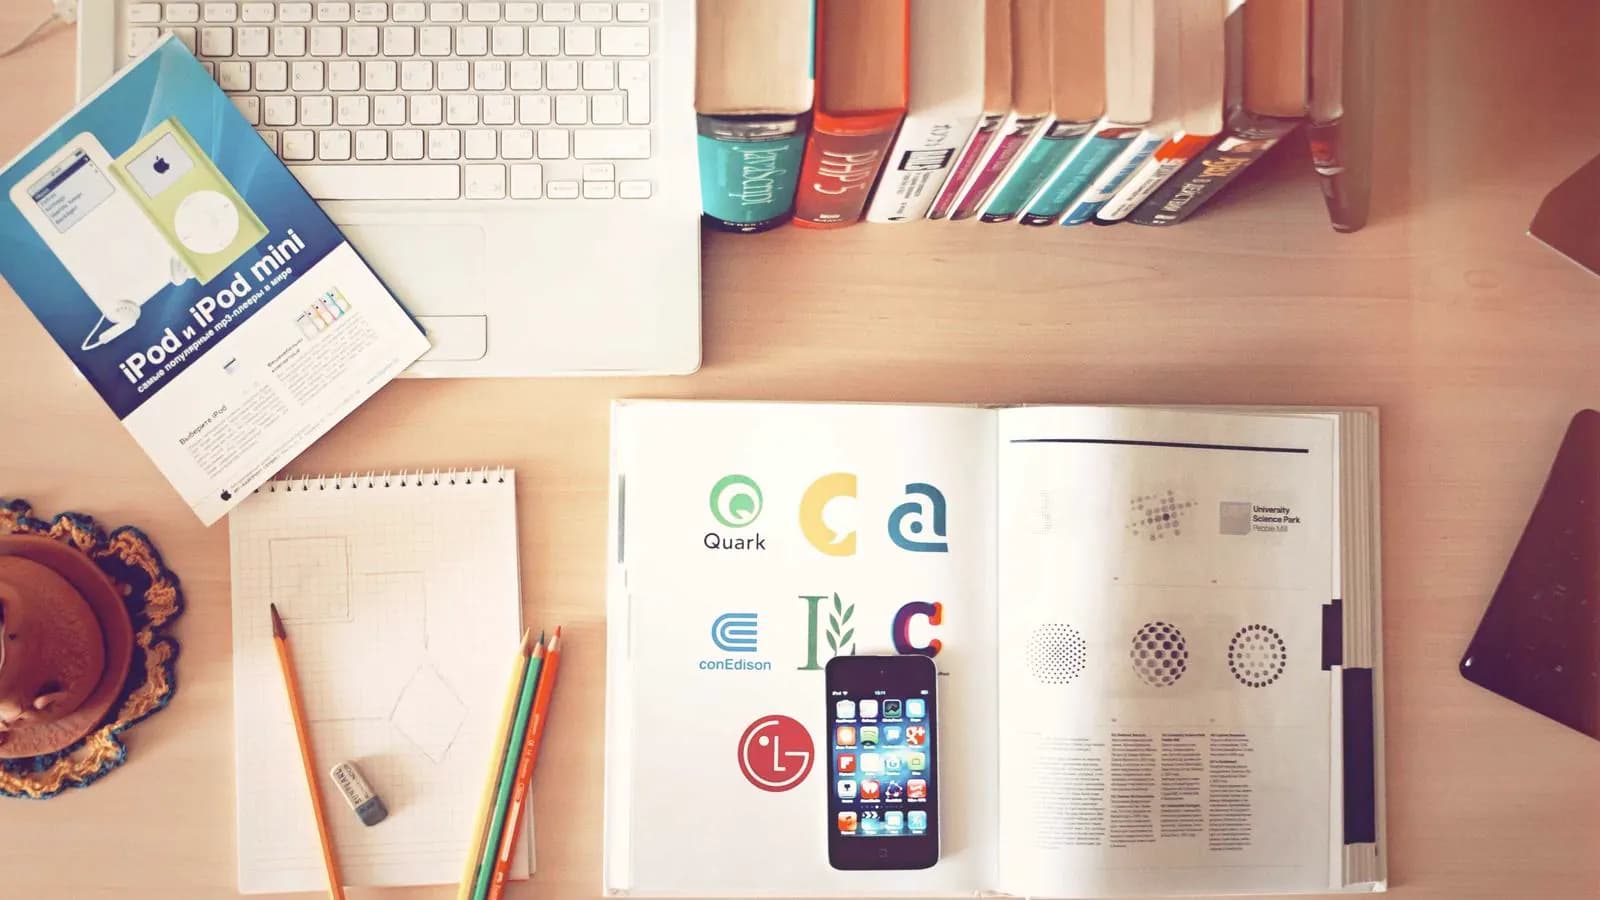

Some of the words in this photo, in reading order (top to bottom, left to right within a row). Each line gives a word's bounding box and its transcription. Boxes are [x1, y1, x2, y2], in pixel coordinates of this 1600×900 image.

[728, 144, 790, 206] JavaScript
[818, 149, 879, 183] PHP
[813, 182, 867, 195] 5
[250, 228, 306, 282] mini
[189, 271, 252, 328] iPod
[137, 367, 165, 394] самые
[165, 329, 215, 372] популярные
[213, 289, 265, 333] mp3-плееры
[270, 266, 293, 286] мире
[182, 324, 197, 340] и
[118, 327, 183, 385] iPod
[1253, 505, 1290, 515] University
[1253, 514, 1282, 523] Science
[1283, 515, 1301, 524] Park
[703, 532, 766, 551] Quark
[699, 658, 772, 671] conEdison
